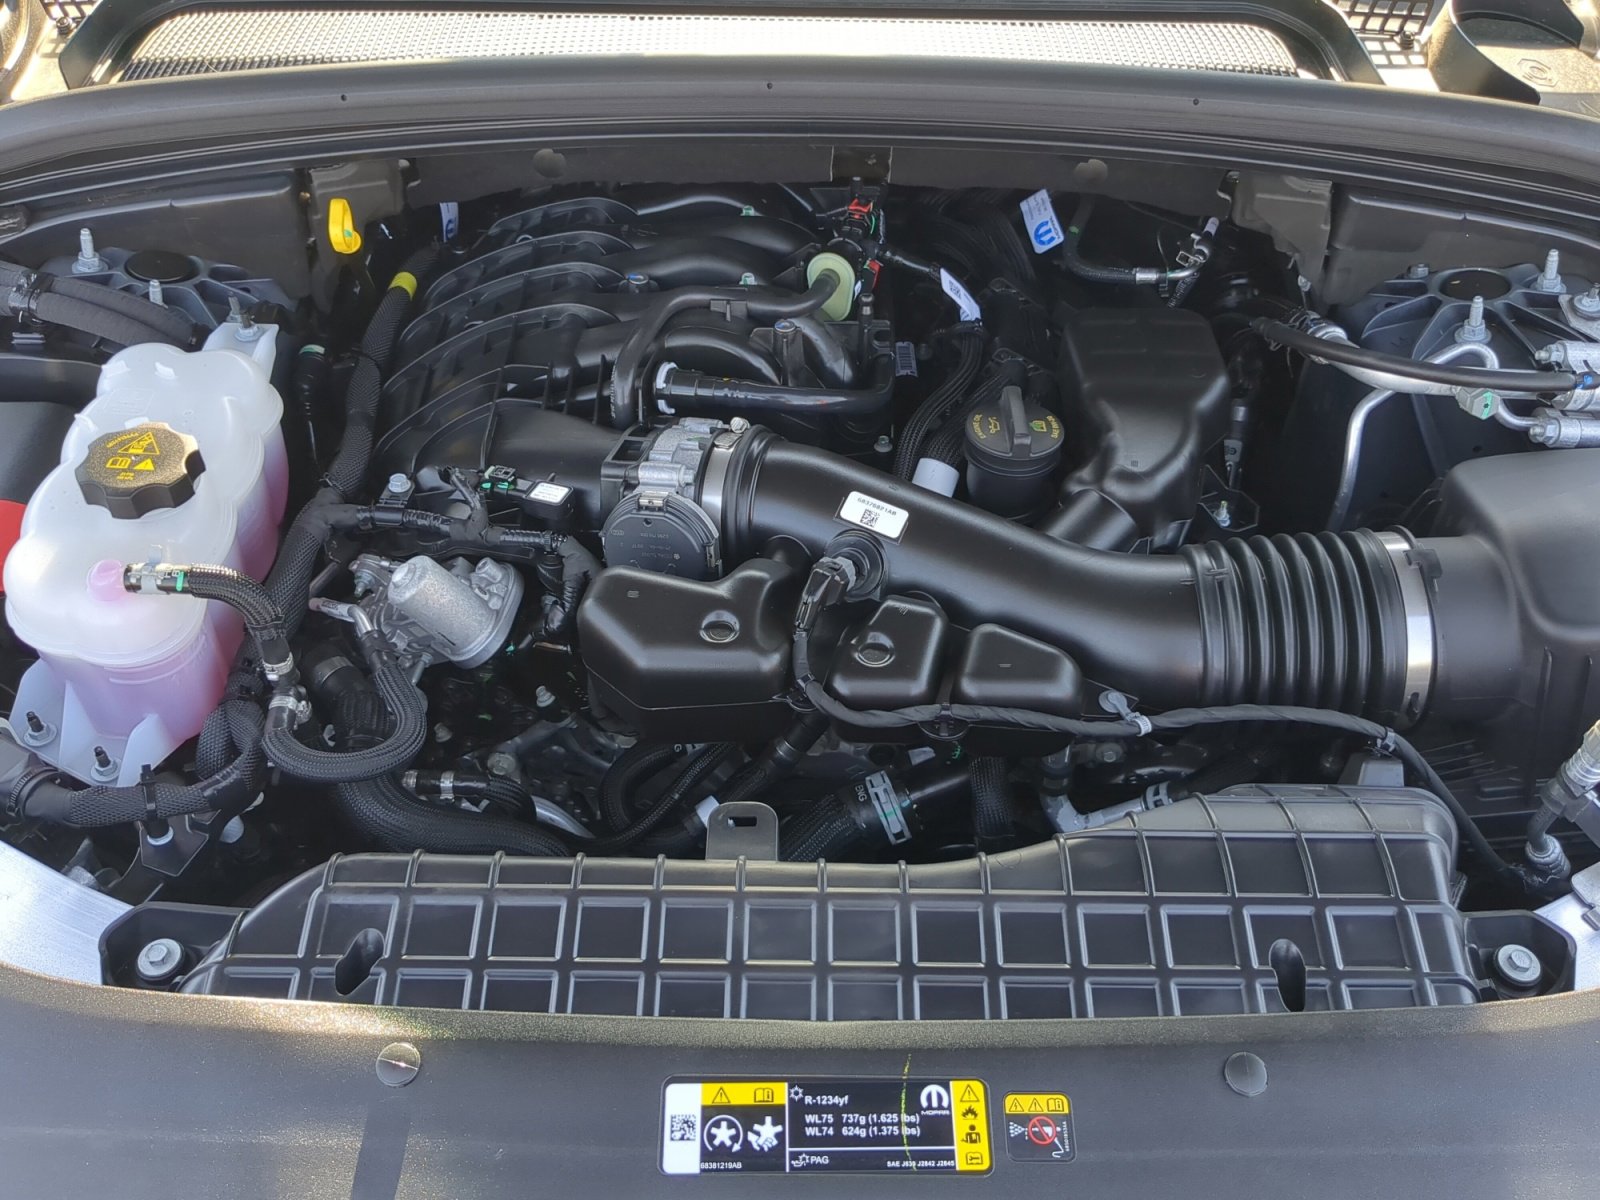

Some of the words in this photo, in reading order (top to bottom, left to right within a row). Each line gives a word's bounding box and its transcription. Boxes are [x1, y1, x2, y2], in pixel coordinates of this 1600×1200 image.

[804, 1095, 849, 1107] R-1234yf
[805, 1114, 834, 1123] WL75
[841, 1114, 866, 1125] 737g
[868, 1113, 898, 1125] (1.625
[901, 1113, 920, 1125] lbs)
[805, 1127, 834, 1136] WL74
[842, 1127, 866, 1138] 624g
[869, 1126, 899, 1138] (1.375
[901, 1126, 921, 1138] lbs)
[810, 1156, 830, 1164] PAG
